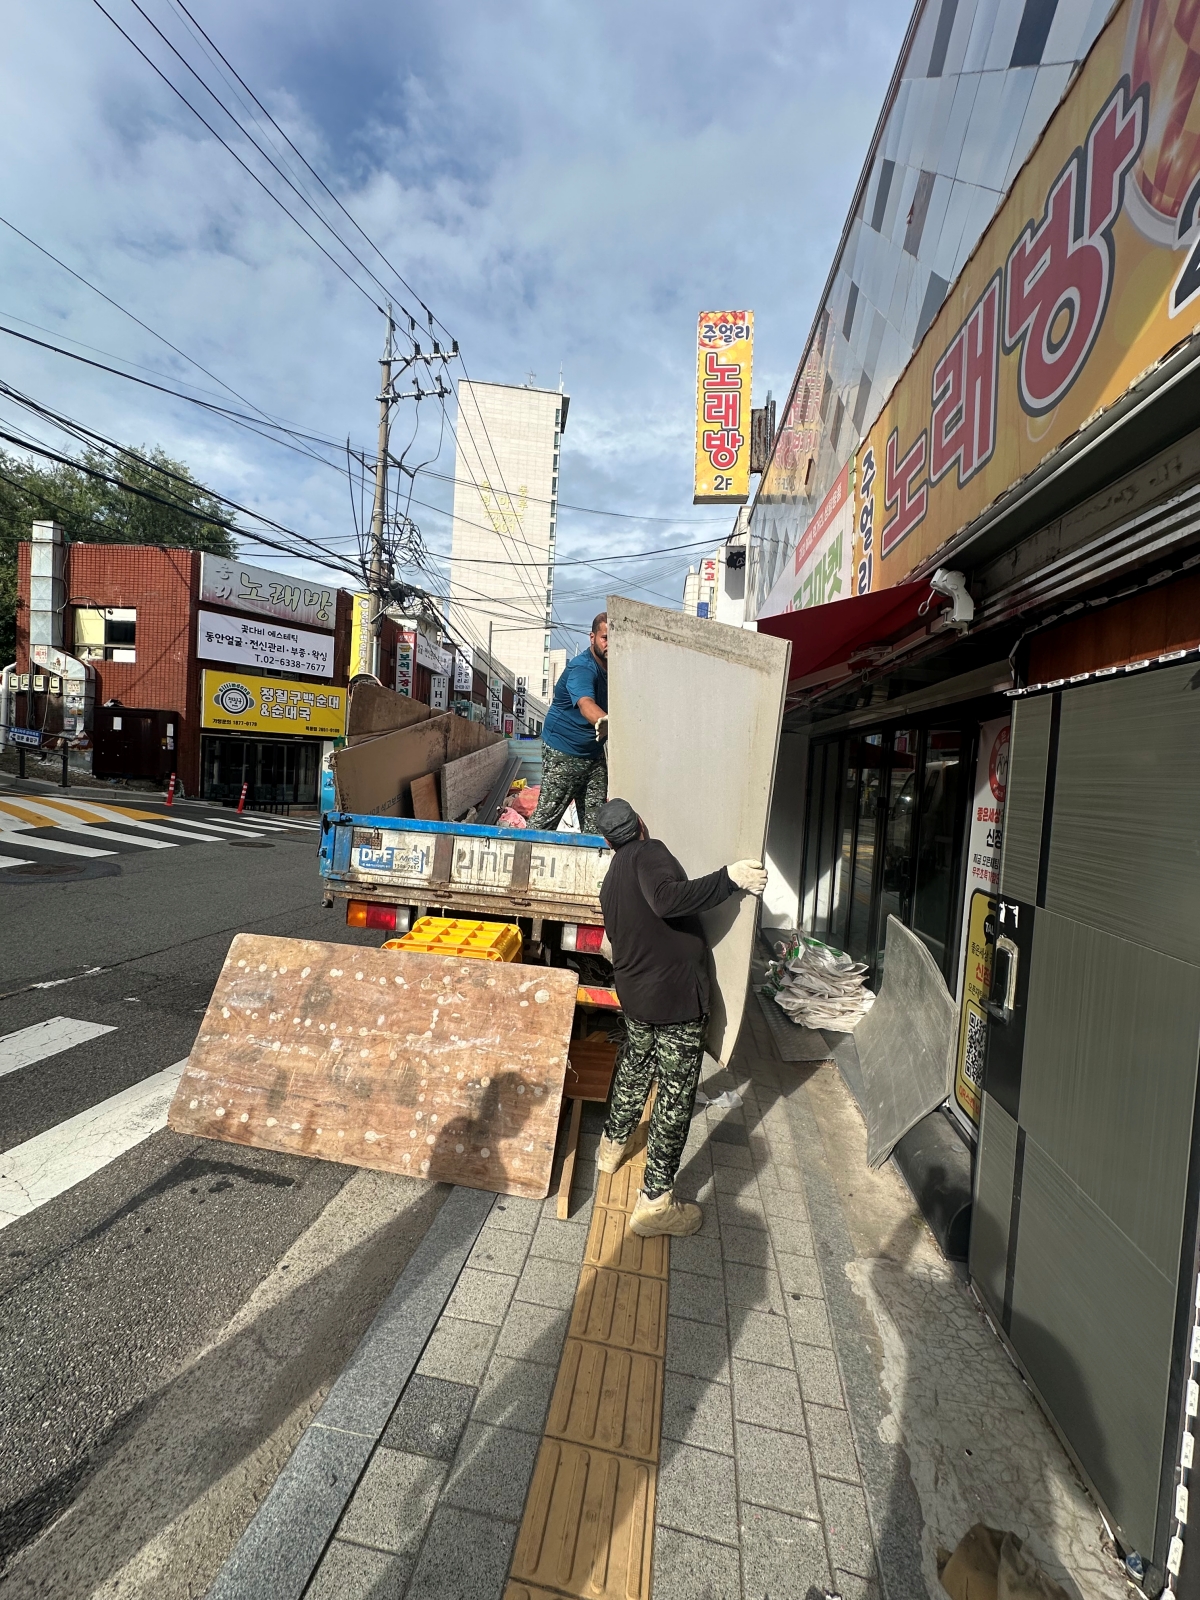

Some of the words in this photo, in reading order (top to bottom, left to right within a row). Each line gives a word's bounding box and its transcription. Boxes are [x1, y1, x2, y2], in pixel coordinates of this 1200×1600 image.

[881, 74, 1151, 561] 노래방
[702, 324, 750, 343] 주얼리
[703, 352, 744, 470] 노래방
[713, 475, 733, 491] 2F
[858, 448, 876, 595] 주얼리
[238, 572, 333, 621] 노래방
[241, 624, 265, 636] 꽃다비
[267, 630, 299, 643] 에스테틱
[205, 631, 243, 647] 동안얼굴
[249, 640, 285, 653] 전신관리
[291, 647, 306, 658] 부종
[311, 650, 328, 662] 왁싱
[255, 654, 326, 672] T.02-6338-7677
[433, 677, 446, 688] THE
[260, 687, 340, 709] 정칠구백순대
[516, 676, 527, 718] 이판사판
[260, 703, 311, 721] &순대국
